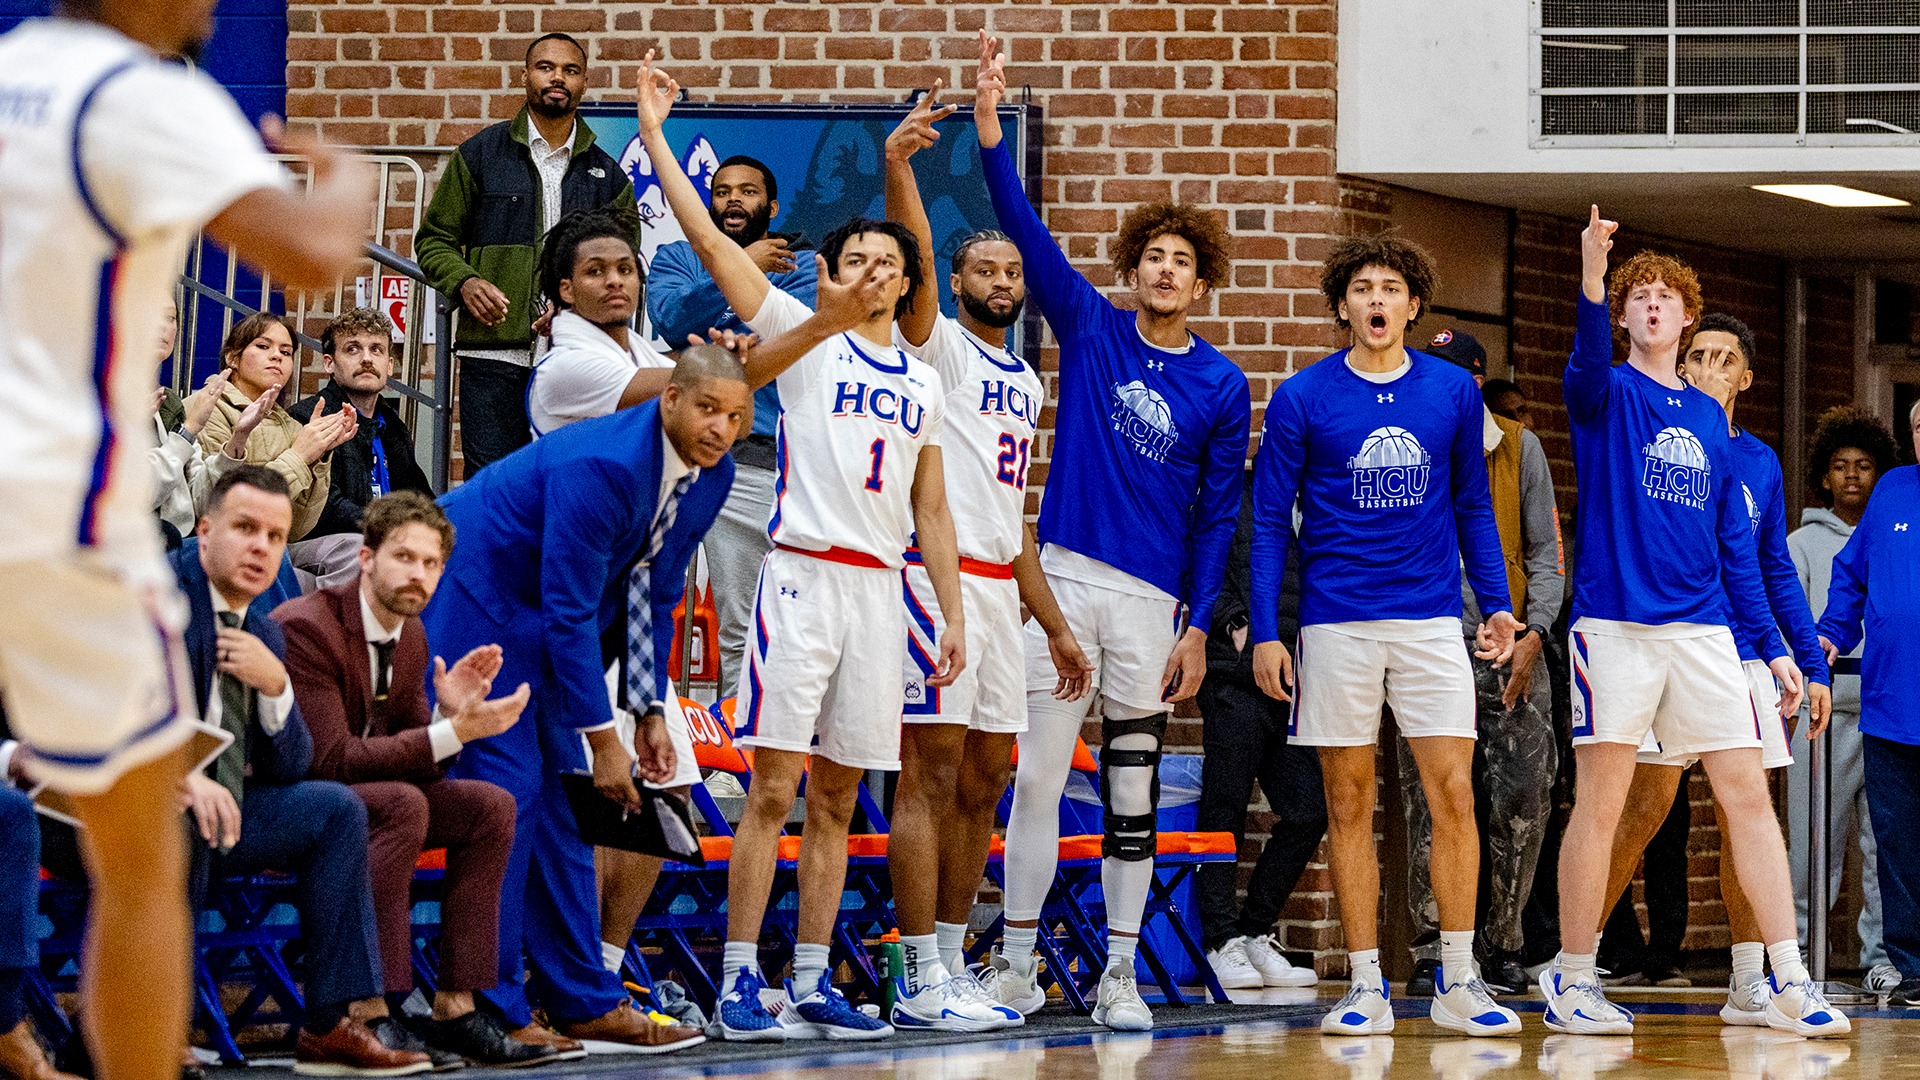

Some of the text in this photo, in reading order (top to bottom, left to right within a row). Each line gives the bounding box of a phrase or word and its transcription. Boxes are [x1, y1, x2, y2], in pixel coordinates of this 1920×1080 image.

[386, 279, 409, 297] AE
[831, 381, 926, 439] HCU
[979, 380, 1037, 433] HCU
[864, 437, 886, 493] 1
[996, 431, 1029, 491] 21
[1352, 465, 1430, 500] HCU
[1642, 457, 1711, 502] HCU
[1359, 496, 1423, 509] BASKETBALL
[1646, 488, 1705, 512] BASKETBALL
[686, 705, 723, 747] CU
